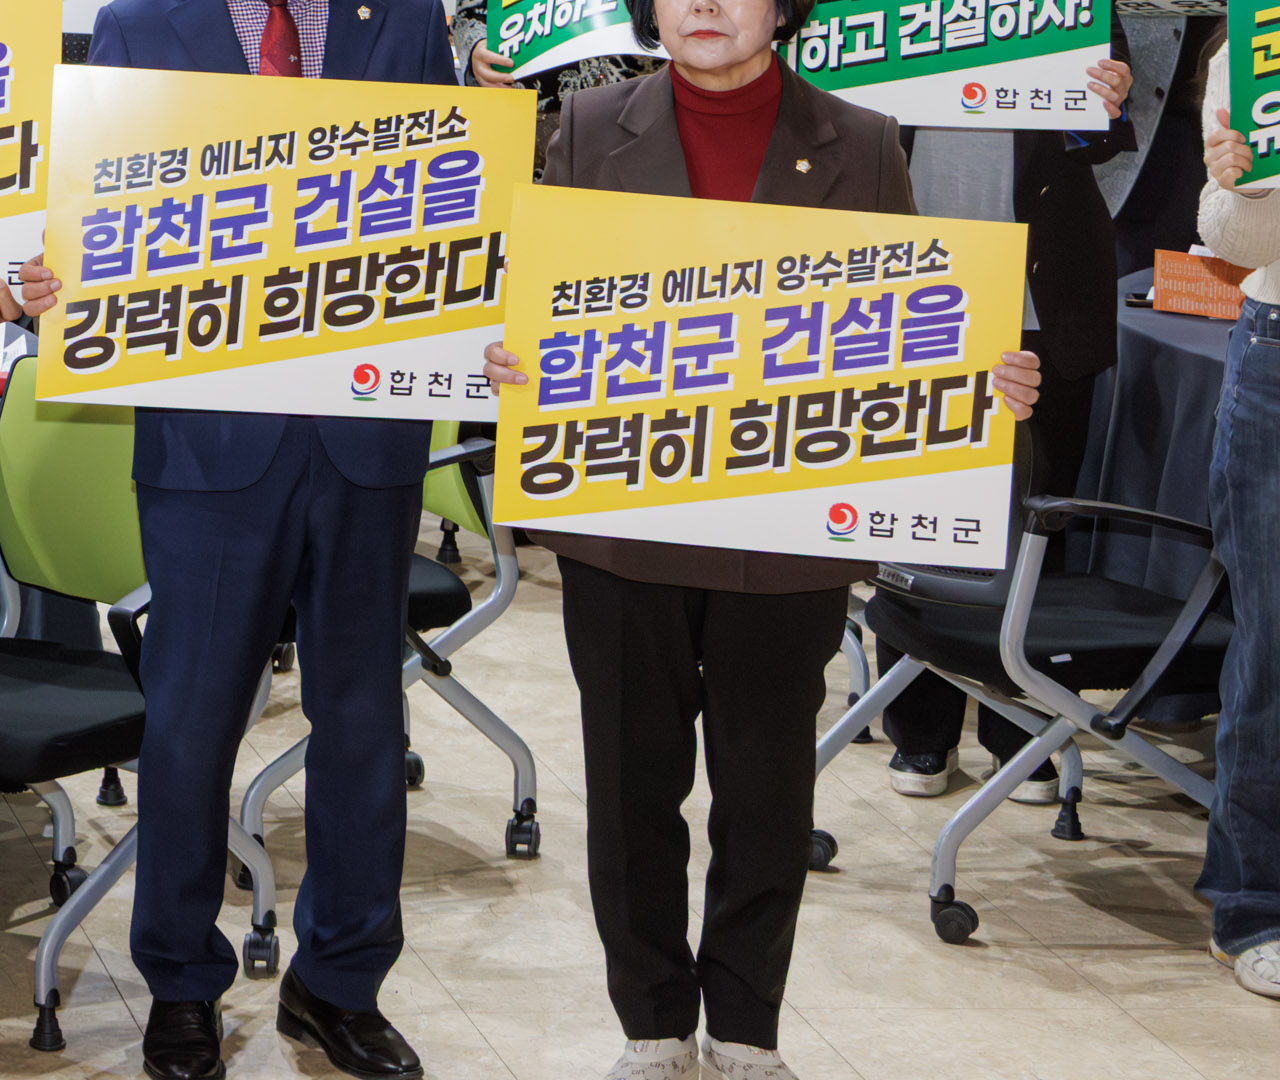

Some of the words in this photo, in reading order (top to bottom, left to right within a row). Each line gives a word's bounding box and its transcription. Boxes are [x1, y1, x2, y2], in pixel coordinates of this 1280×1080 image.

[94, 148, 188, 195] 친환경
[200, 131, 297, 179] 에너지
[308, 106, 470, 162] 양수발전소
[81, 183, 272, 284] 합천군
[294, 150, 484, 249] 건설을
[551, 273, 650, 318] 친환경
[662, 259, 765, 306] 에너지
[776, 238, 952, 293] 양수발전소
[63, 274, 245, 371] 강력히
[259, 231, 506, 338] 희망한다
[538, 311, 738, 407] 합천군
[761, 285, 968, 381] 건설을
[520, 405, 710, 497] 강력히
[725, 370, 995, 475] 희망한다
